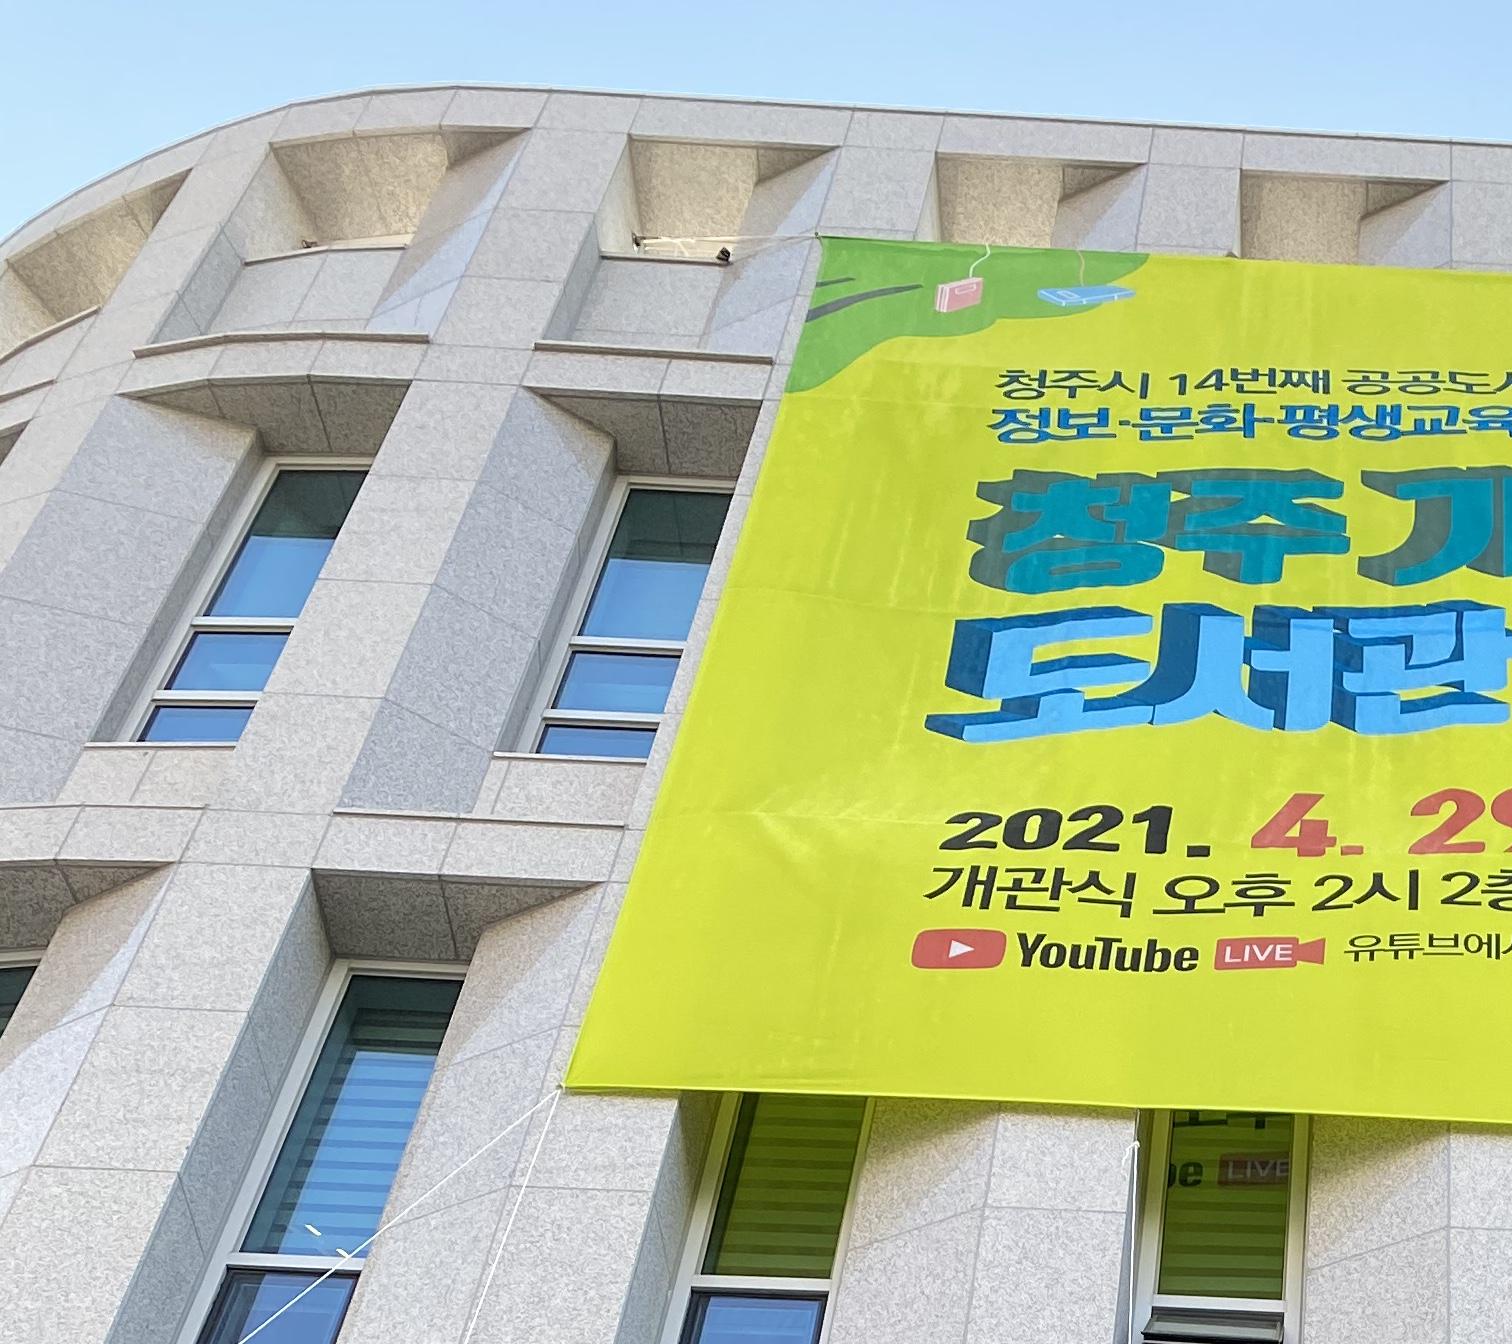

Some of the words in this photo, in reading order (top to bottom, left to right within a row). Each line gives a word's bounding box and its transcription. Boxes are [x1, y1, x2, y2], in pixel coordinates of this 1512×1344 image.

[993, 367, 1149, 401] 청주시
[1168, 367, 1331, 396] 14번째
[966, 468, 1351, 594] 청주
[938, 803, 1211, 858] 2021.
[1250, 792, 1364, 858] 4.
[923, 862, 1136, 918] 개관식
[1150, 866, 1295, 917] 오후
[1313, 871, 1421, 914] 2시
[1015, 931, 1201, 974] YouTube
[1222, 941, 1294, 966] LIVE
